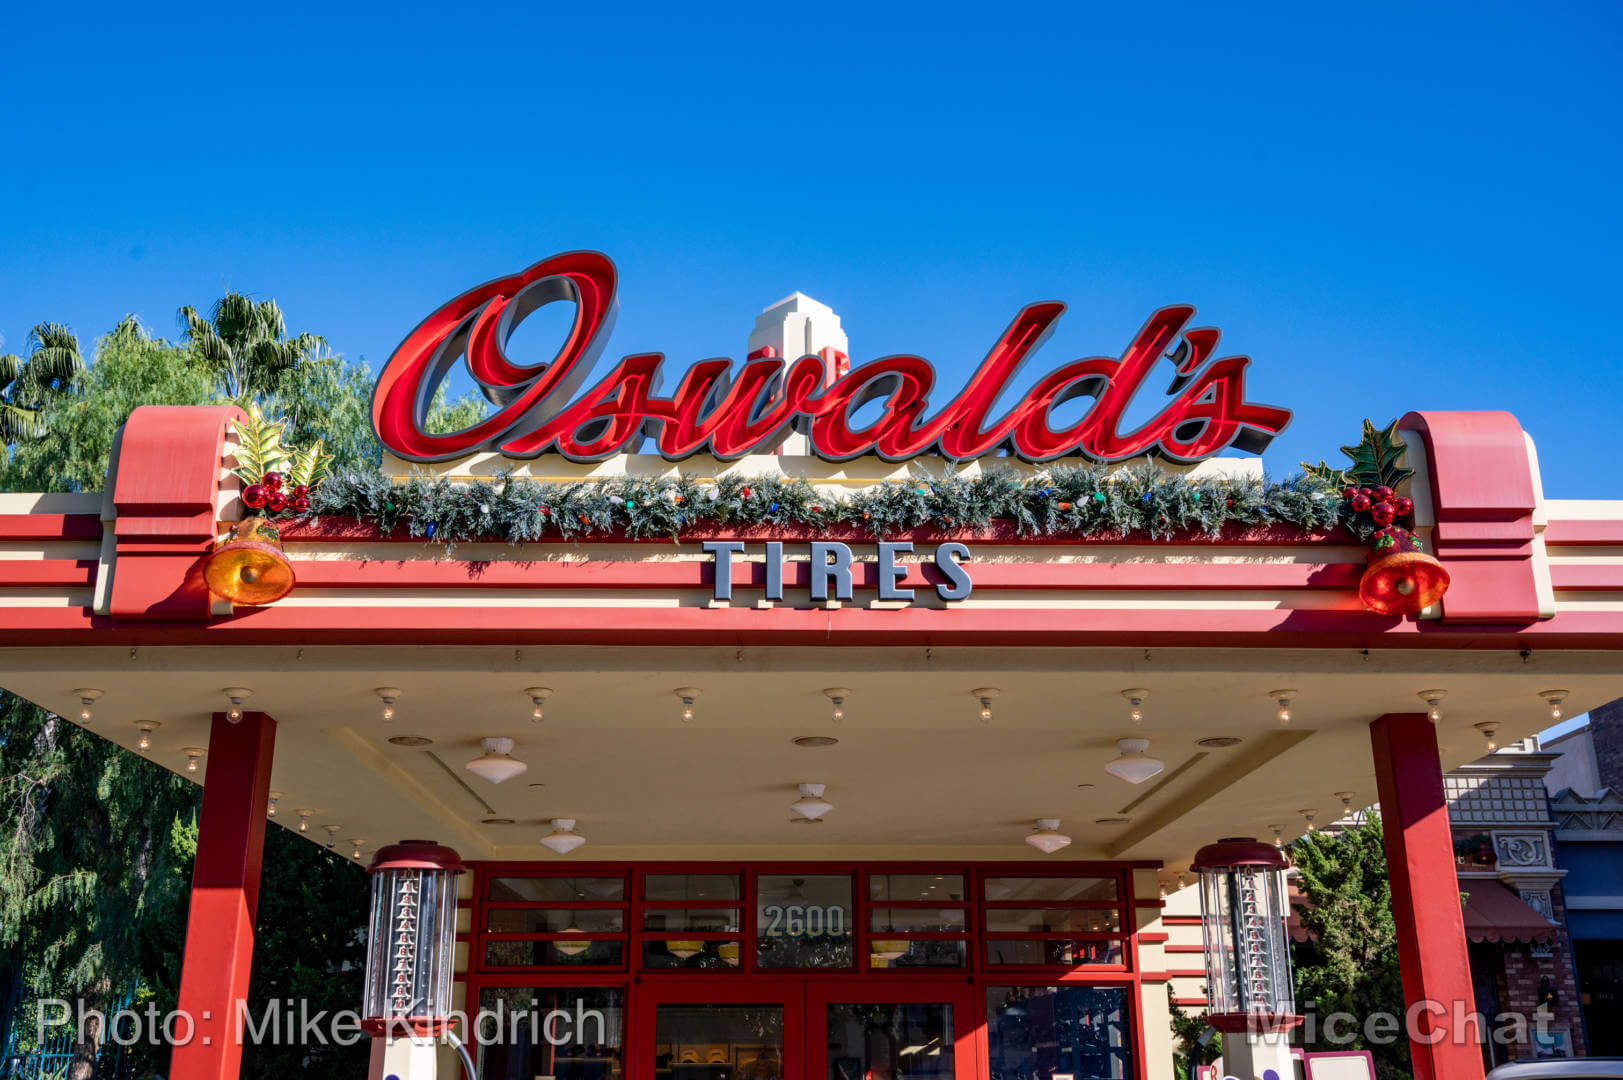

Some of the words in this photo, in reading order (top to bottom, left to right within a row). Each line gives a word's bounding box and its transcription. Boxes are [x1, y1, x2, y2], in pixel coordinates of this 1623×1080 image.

[370, 249, 1293, 463] Oswald's
[702, 541, 972, 601] TIRES
[763, 904, 845, 938] 2600
